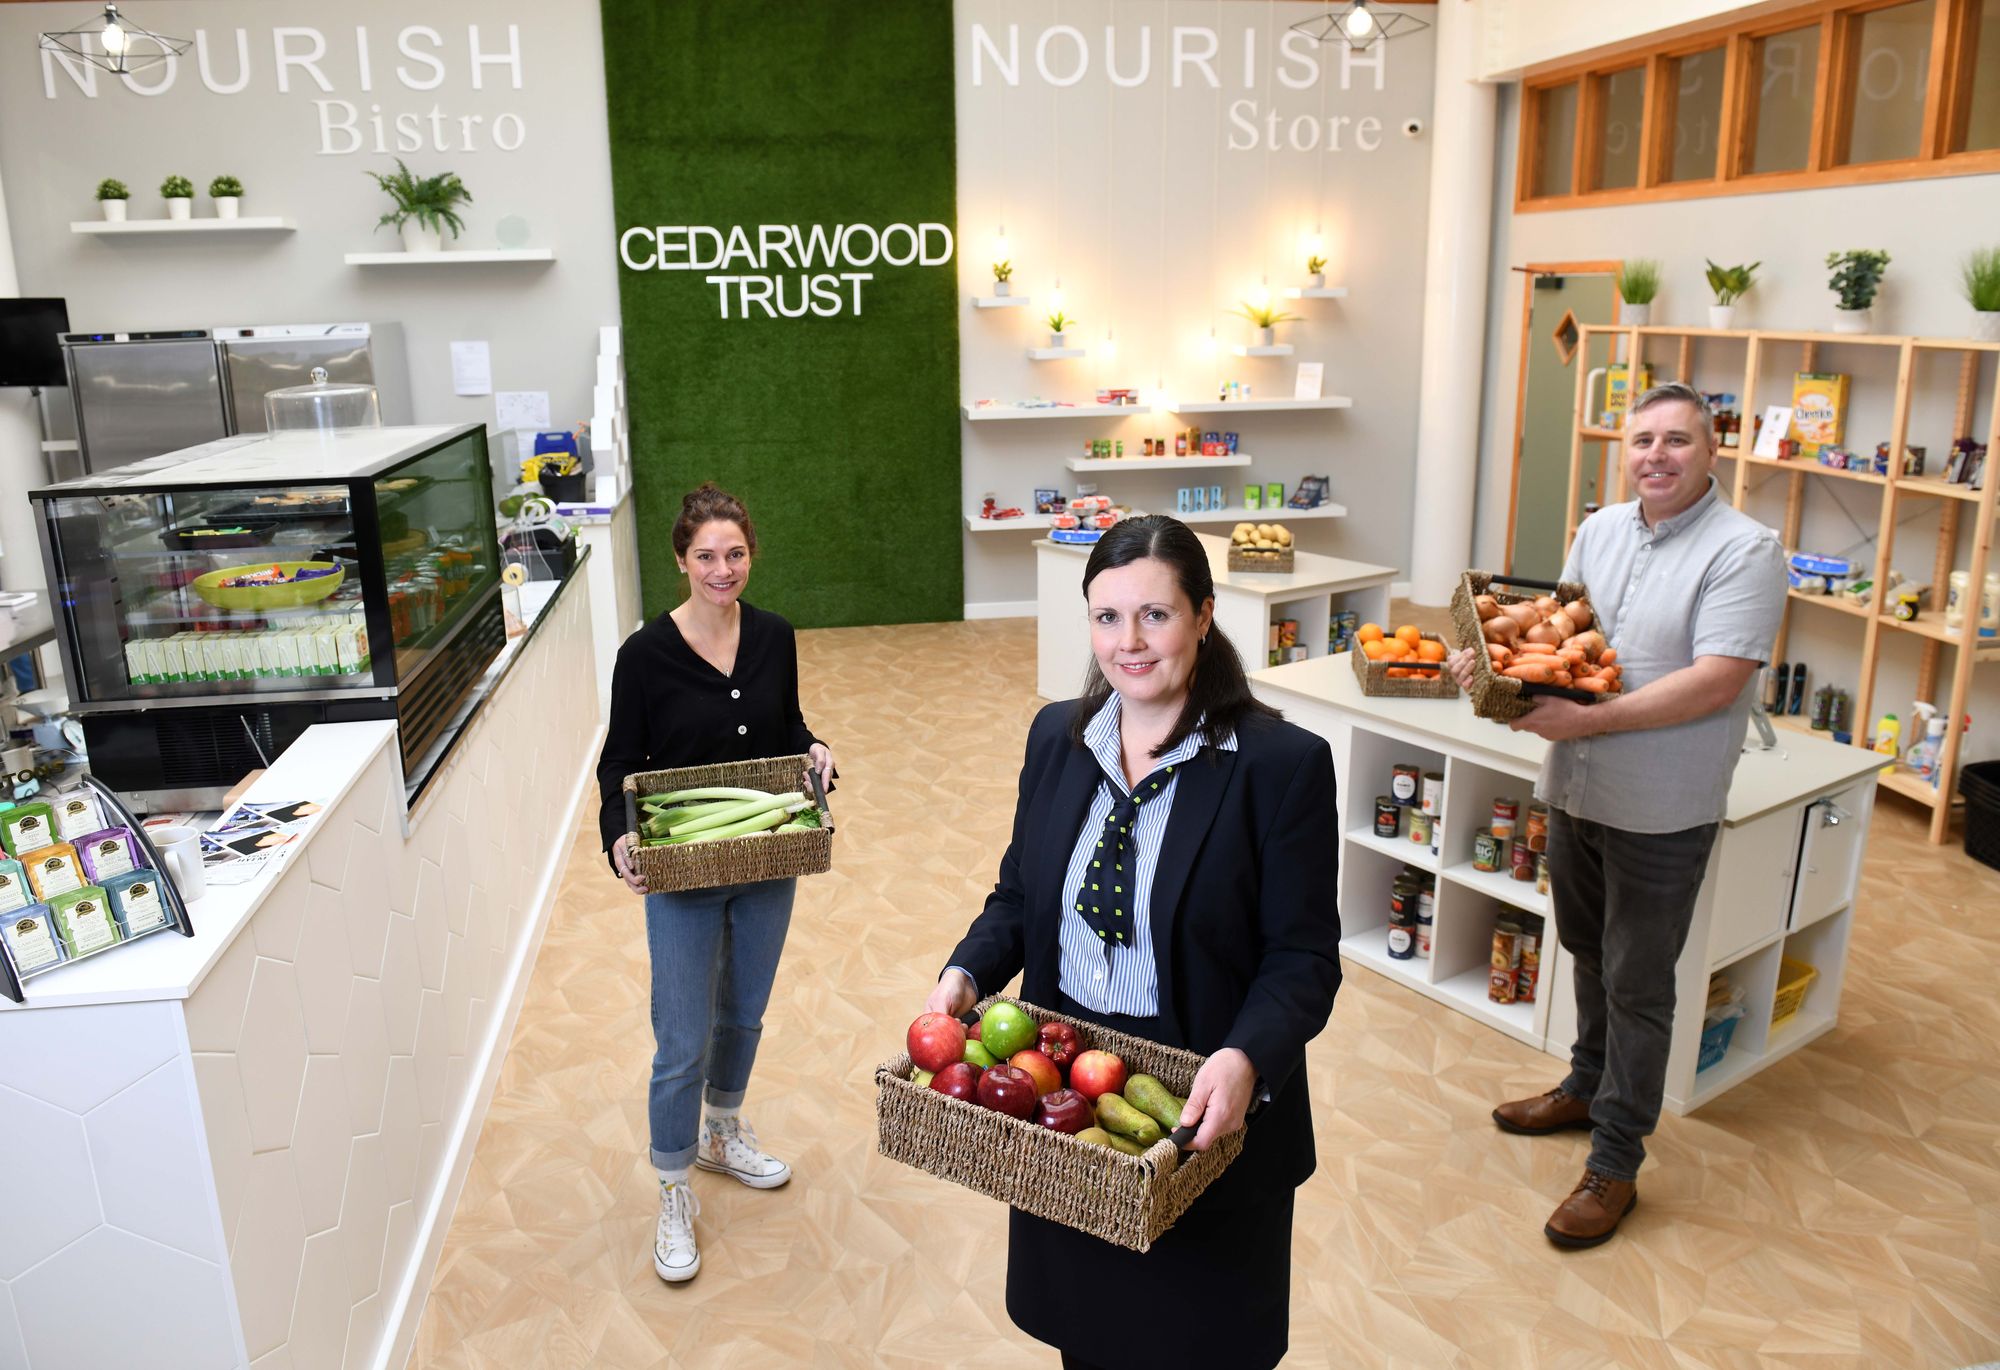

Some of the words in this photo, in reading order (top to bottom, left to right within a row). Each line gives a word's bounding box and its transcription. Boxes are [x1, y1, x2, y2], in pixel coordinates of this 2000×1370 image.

[38, 24, 524, 99] NOURISH
[971, 23, 1386, 92] NOURISH
[313, 100, 527, 156] Bistro
[1228, 99, 1383, 152] Store
[620, 223, 954, 271] CEDARWOOD
[706, 273, 873, 320] TRUST
